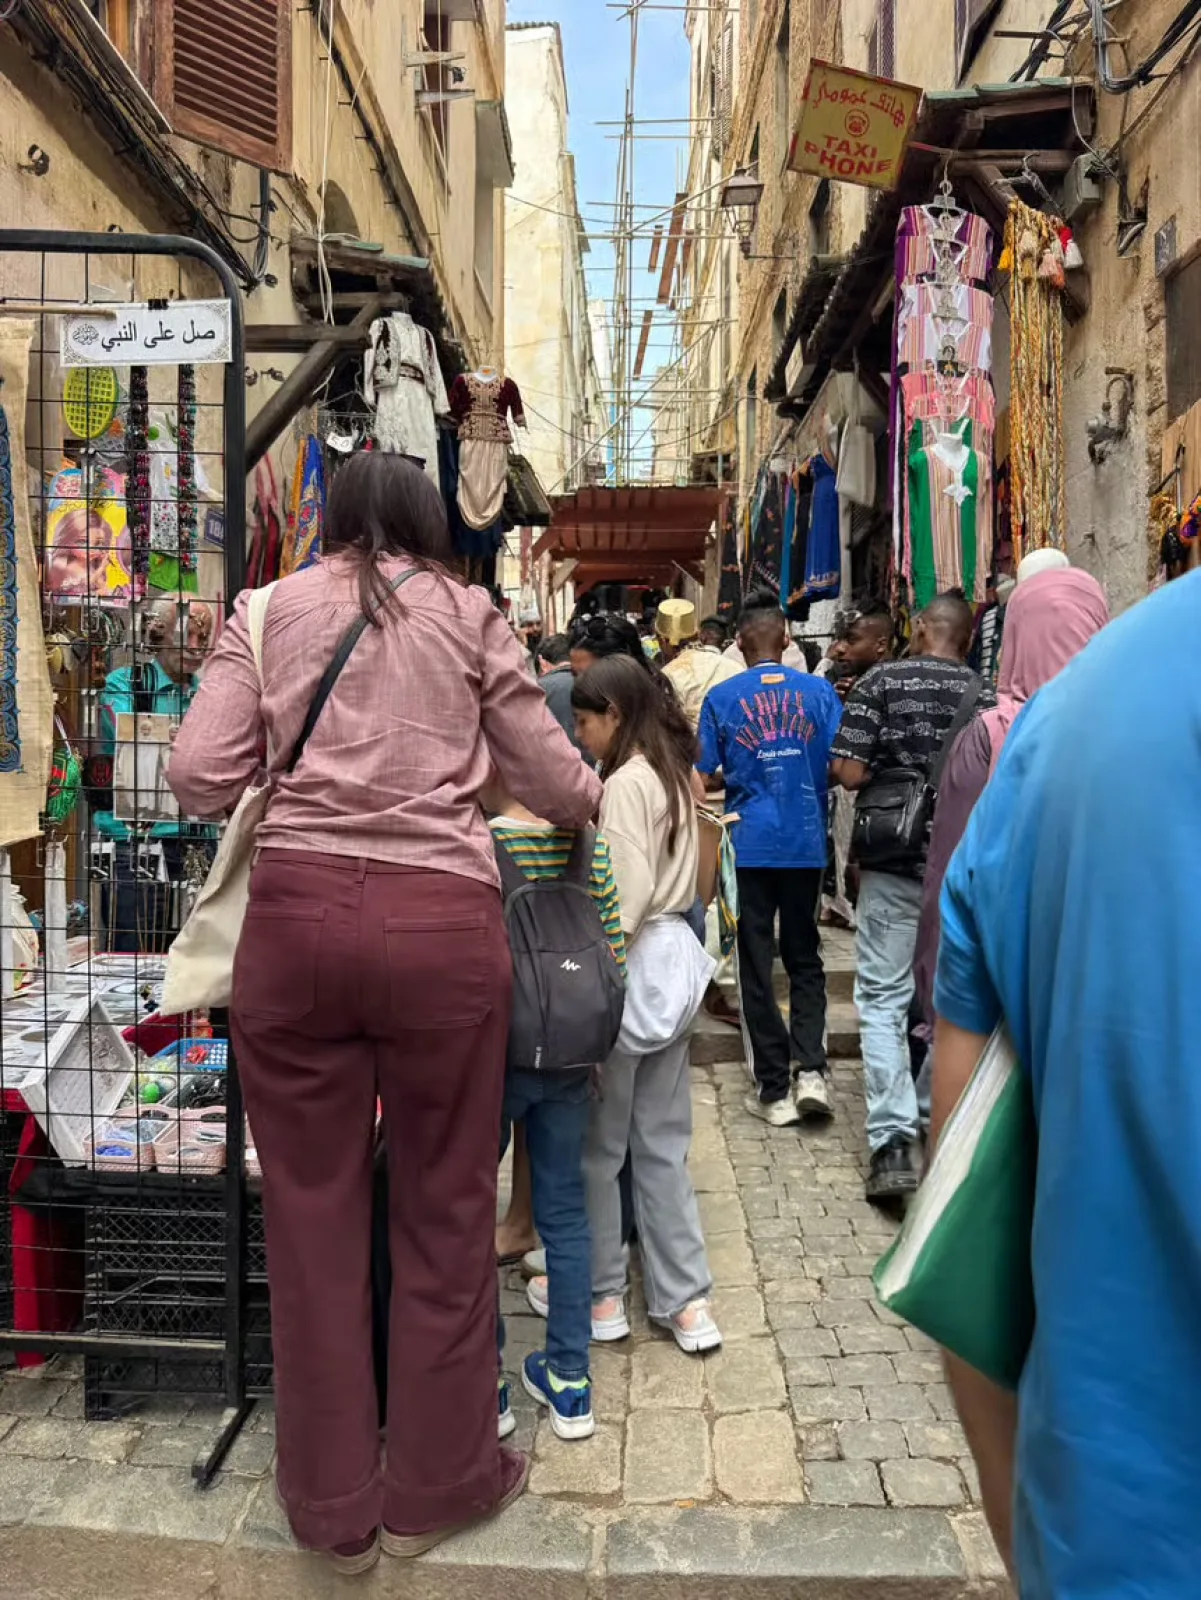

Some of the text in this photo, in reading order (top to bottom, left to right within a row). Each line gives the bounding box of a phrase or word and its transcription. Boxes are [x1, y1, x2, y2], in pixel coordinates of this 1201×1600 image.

[803, 140, 893, 176] PHONE
[823, 134, 878, 159] TAXI
[101, 320, 138, 352] النبي
[143, 320, 175, 349] على
[182, 318, 216, 344] صل
